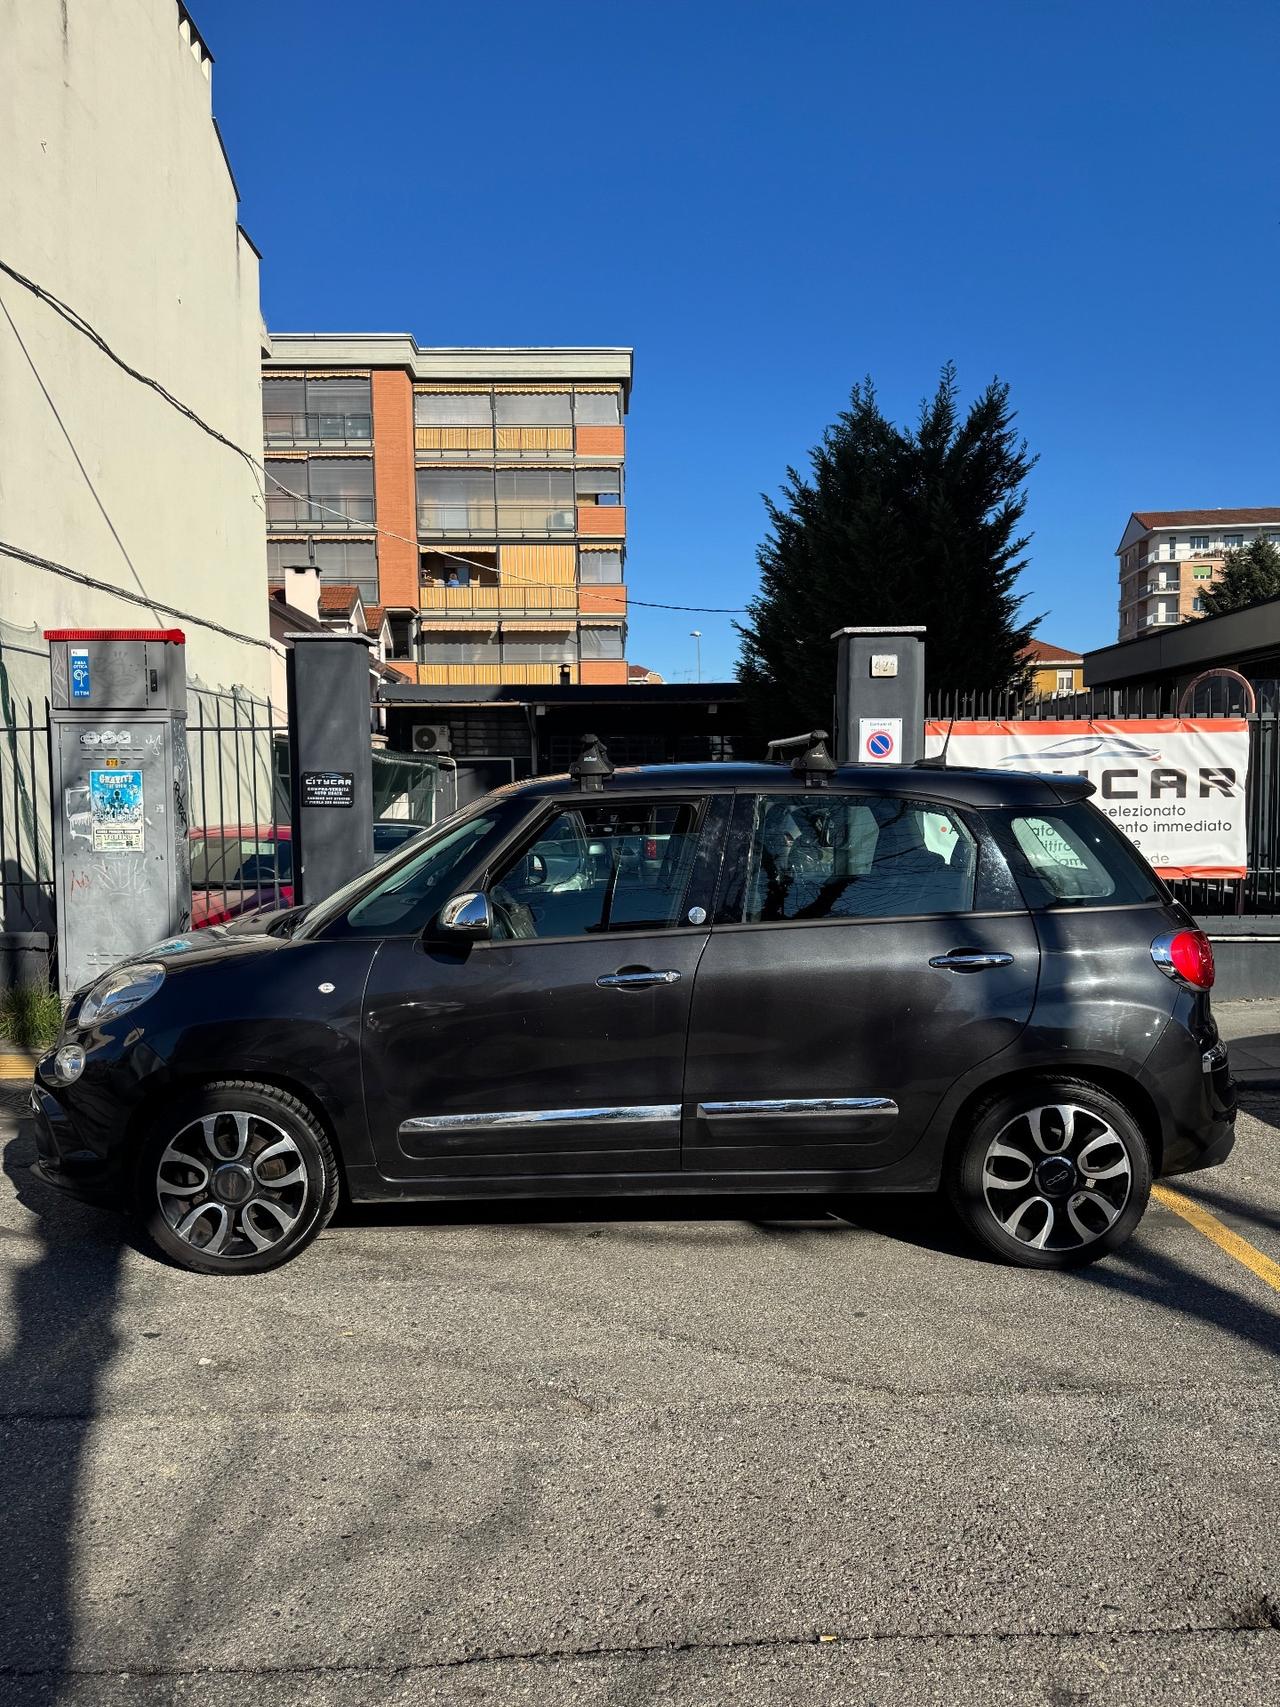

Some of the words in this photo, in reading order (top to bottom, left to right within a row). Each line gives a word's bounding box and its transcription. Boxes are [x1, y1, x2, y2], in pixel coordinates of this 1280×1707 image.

[99, 774, 133, 784] GRAVITY
[1032, 825, 1055, 836] ato
[1117, 821, 1148, 833] ento
[1153, 820, 1232, 832] immediato
